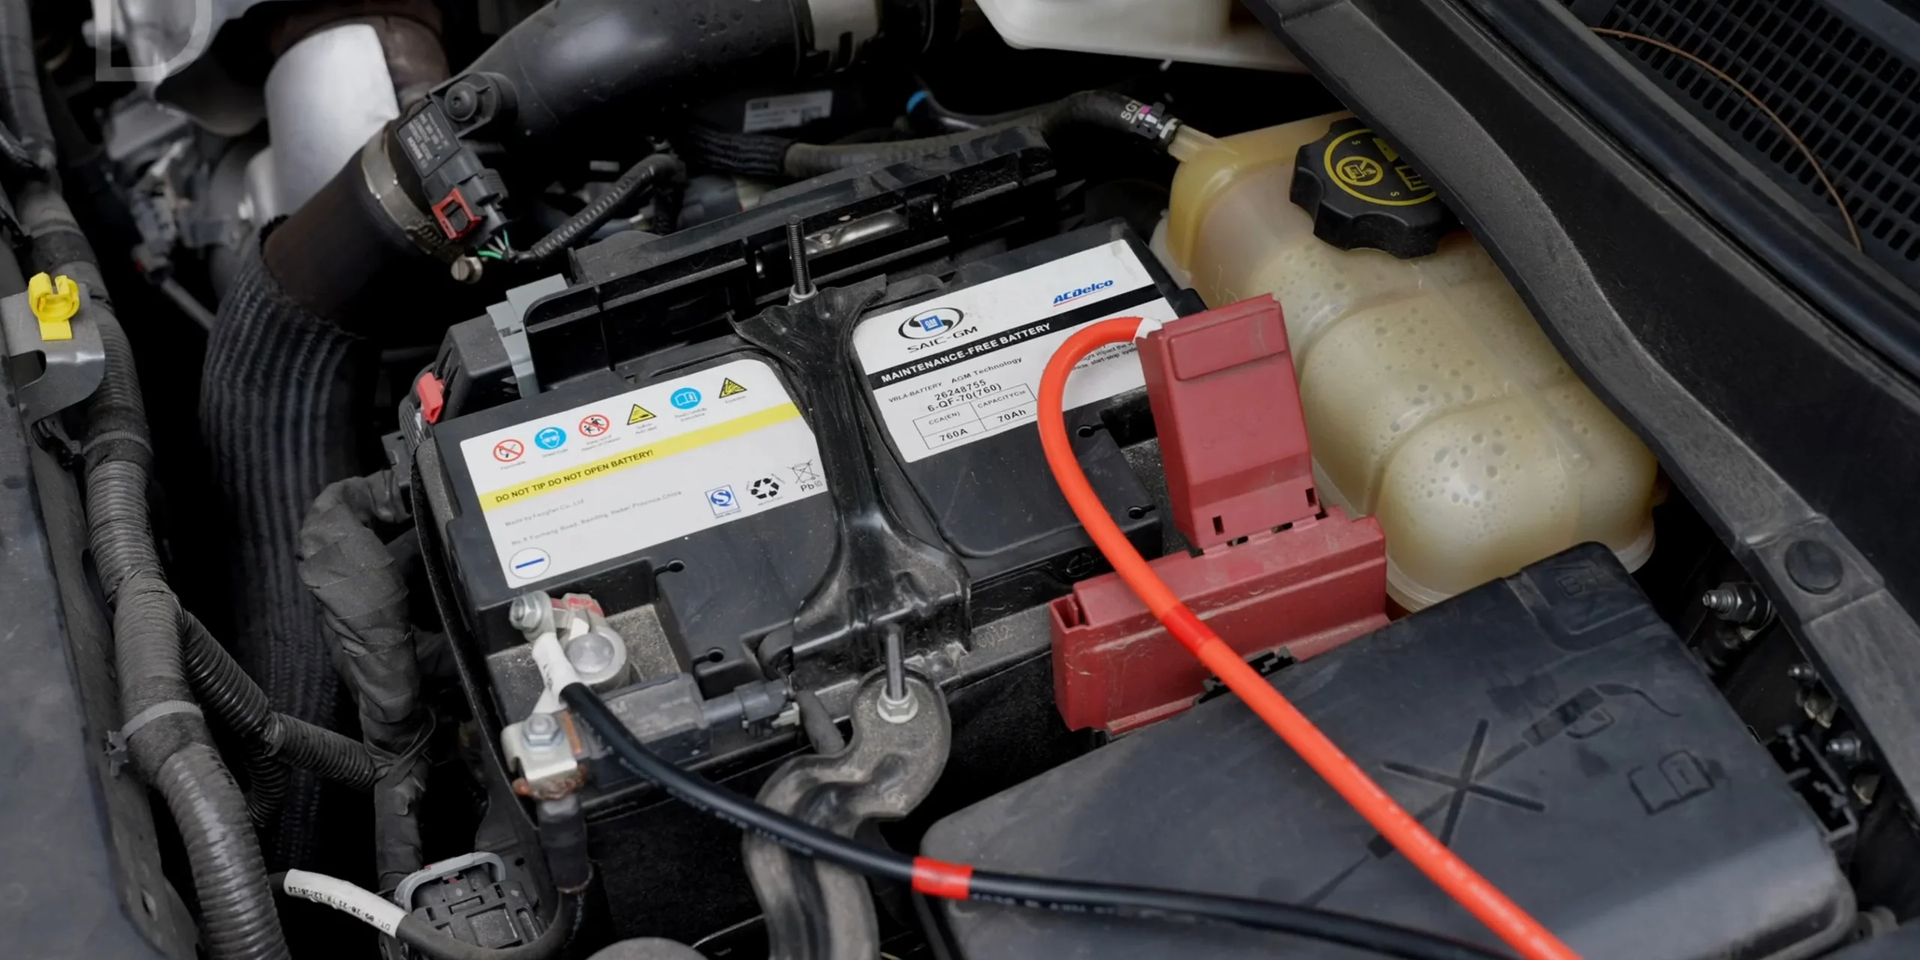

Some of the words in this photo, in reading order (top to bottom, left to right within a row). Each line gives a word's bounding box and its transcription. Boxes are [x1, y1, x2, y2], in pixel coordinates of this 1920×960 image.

[1053, 279, 1114, 305] ACDelco
[881, 338, 999, 383] MAINTENANCE-FREE
[1000, 322, 1051, 345] BATTERY
[907, 326, 978, 353] SAIC-GM
[888, 381, 943, 403] VRLA-BATTERY
[951, 373, 972, 384] AGM
[973, 357, 1023, 376] Technology
[934, 379, 987, 401] 26248755
[927, 383, 1003, 412] 6-QF-70(760)
[928, 411, 961, 425] CCA(EN)
[997, 409, 1027, 423] 70Ah
[939, 428, 969, 442] 760A
[495, 493, 510, 503] DO
[511, 487, 530, 498] NOT
[532, 482, 546, 492] TIP
[548, 477, 562, 487] DO
[563, 471, 583, 482] NOT
[584, 463, 610, 476] OPEN
[611, 449, 654, 468] BATTERY!
